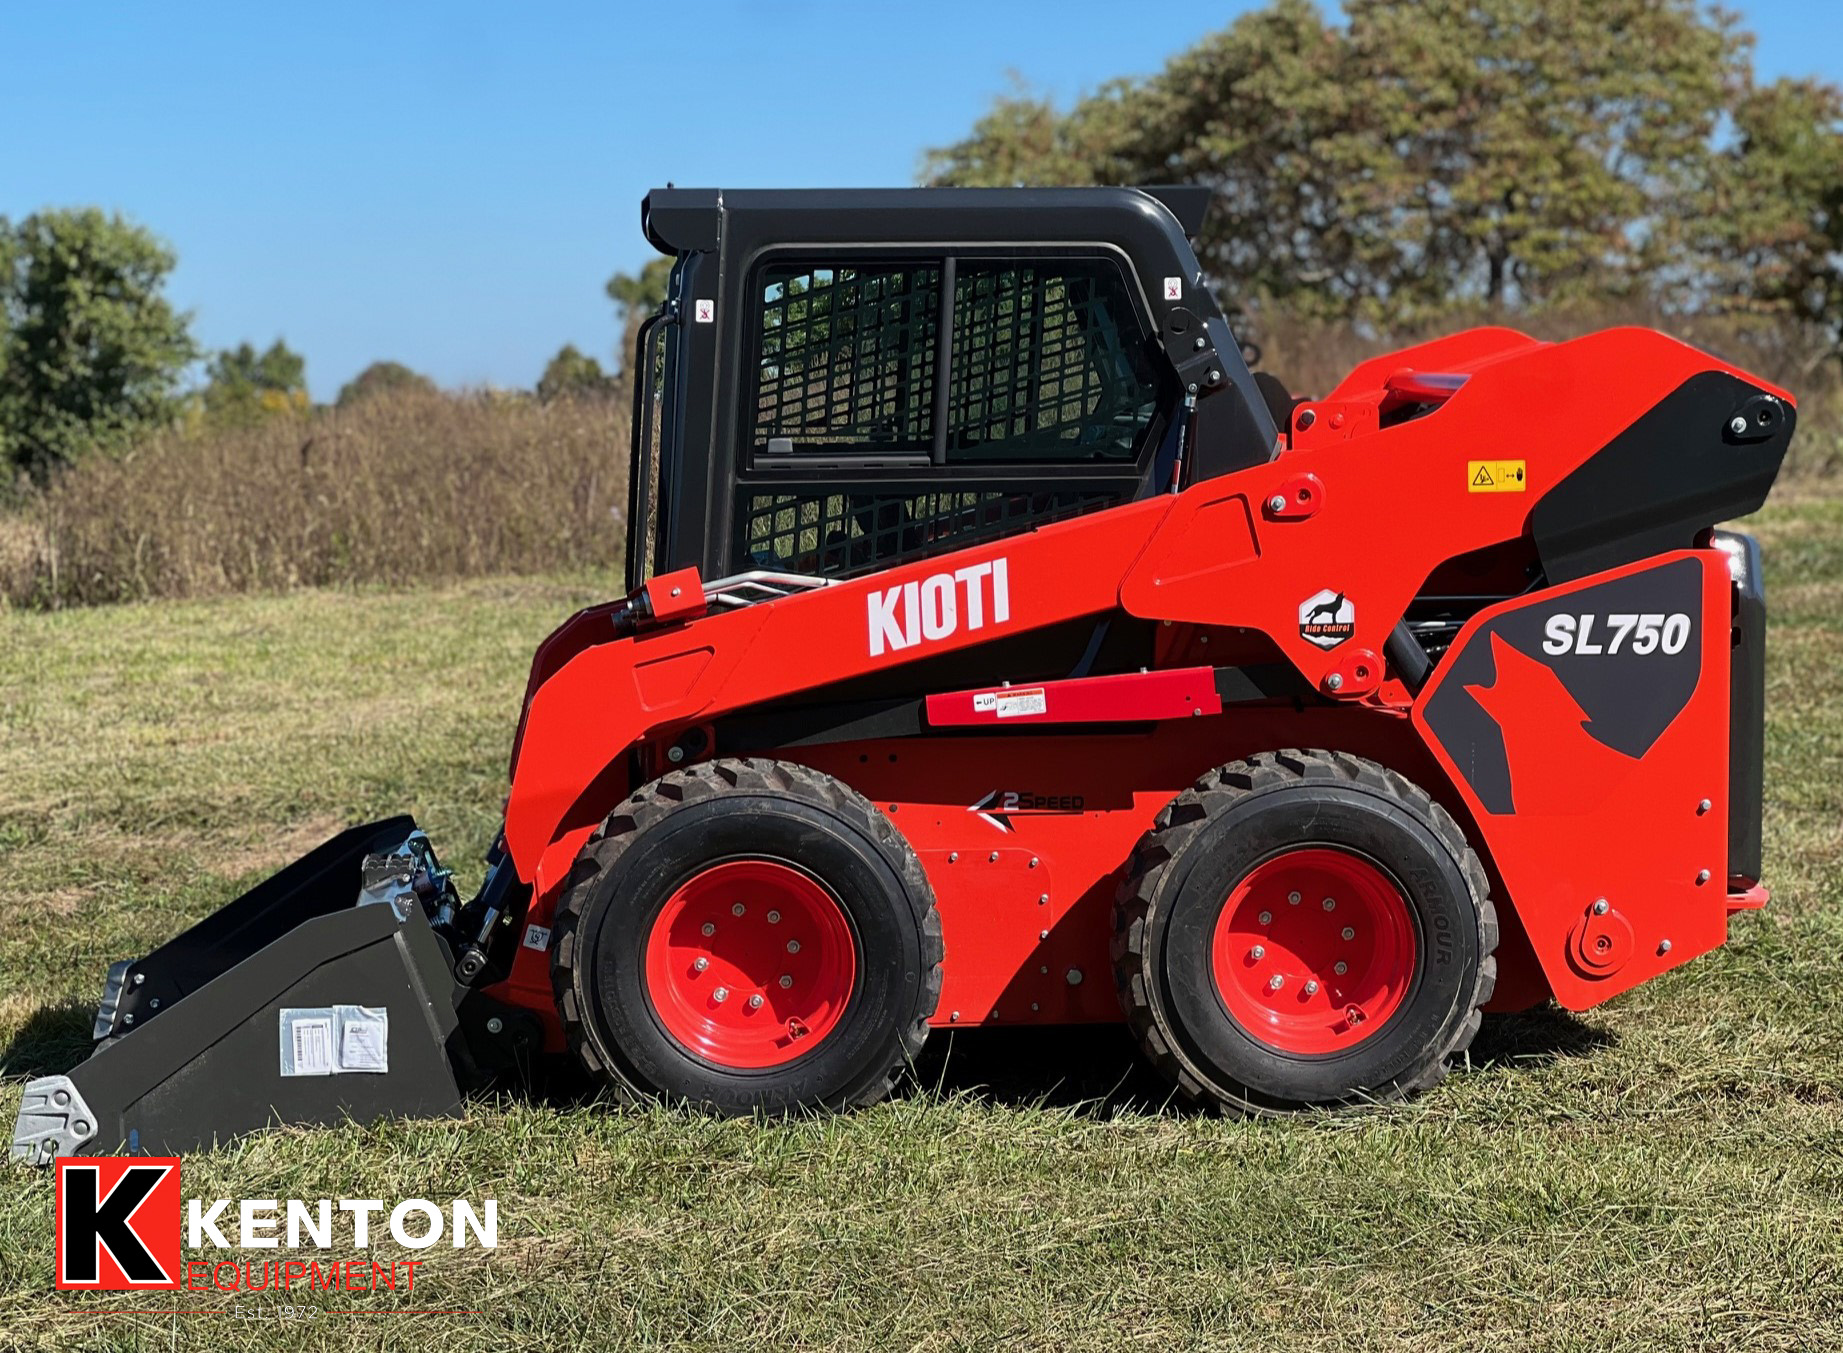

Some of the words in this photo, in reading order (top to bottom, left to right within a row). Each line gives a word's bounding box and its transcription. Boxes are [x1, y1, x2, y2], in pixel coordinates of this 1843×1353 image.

[867, 557, 1010, 657] KIOTI
[1305, 624, 1321, 633] Ride
[1323, 624, 1350, 633] Control
[1542, 613, 1692, 656] SL750
[983, 697, 995, 706] UP
[1408, 868, 1453, 966] ARMOUR
